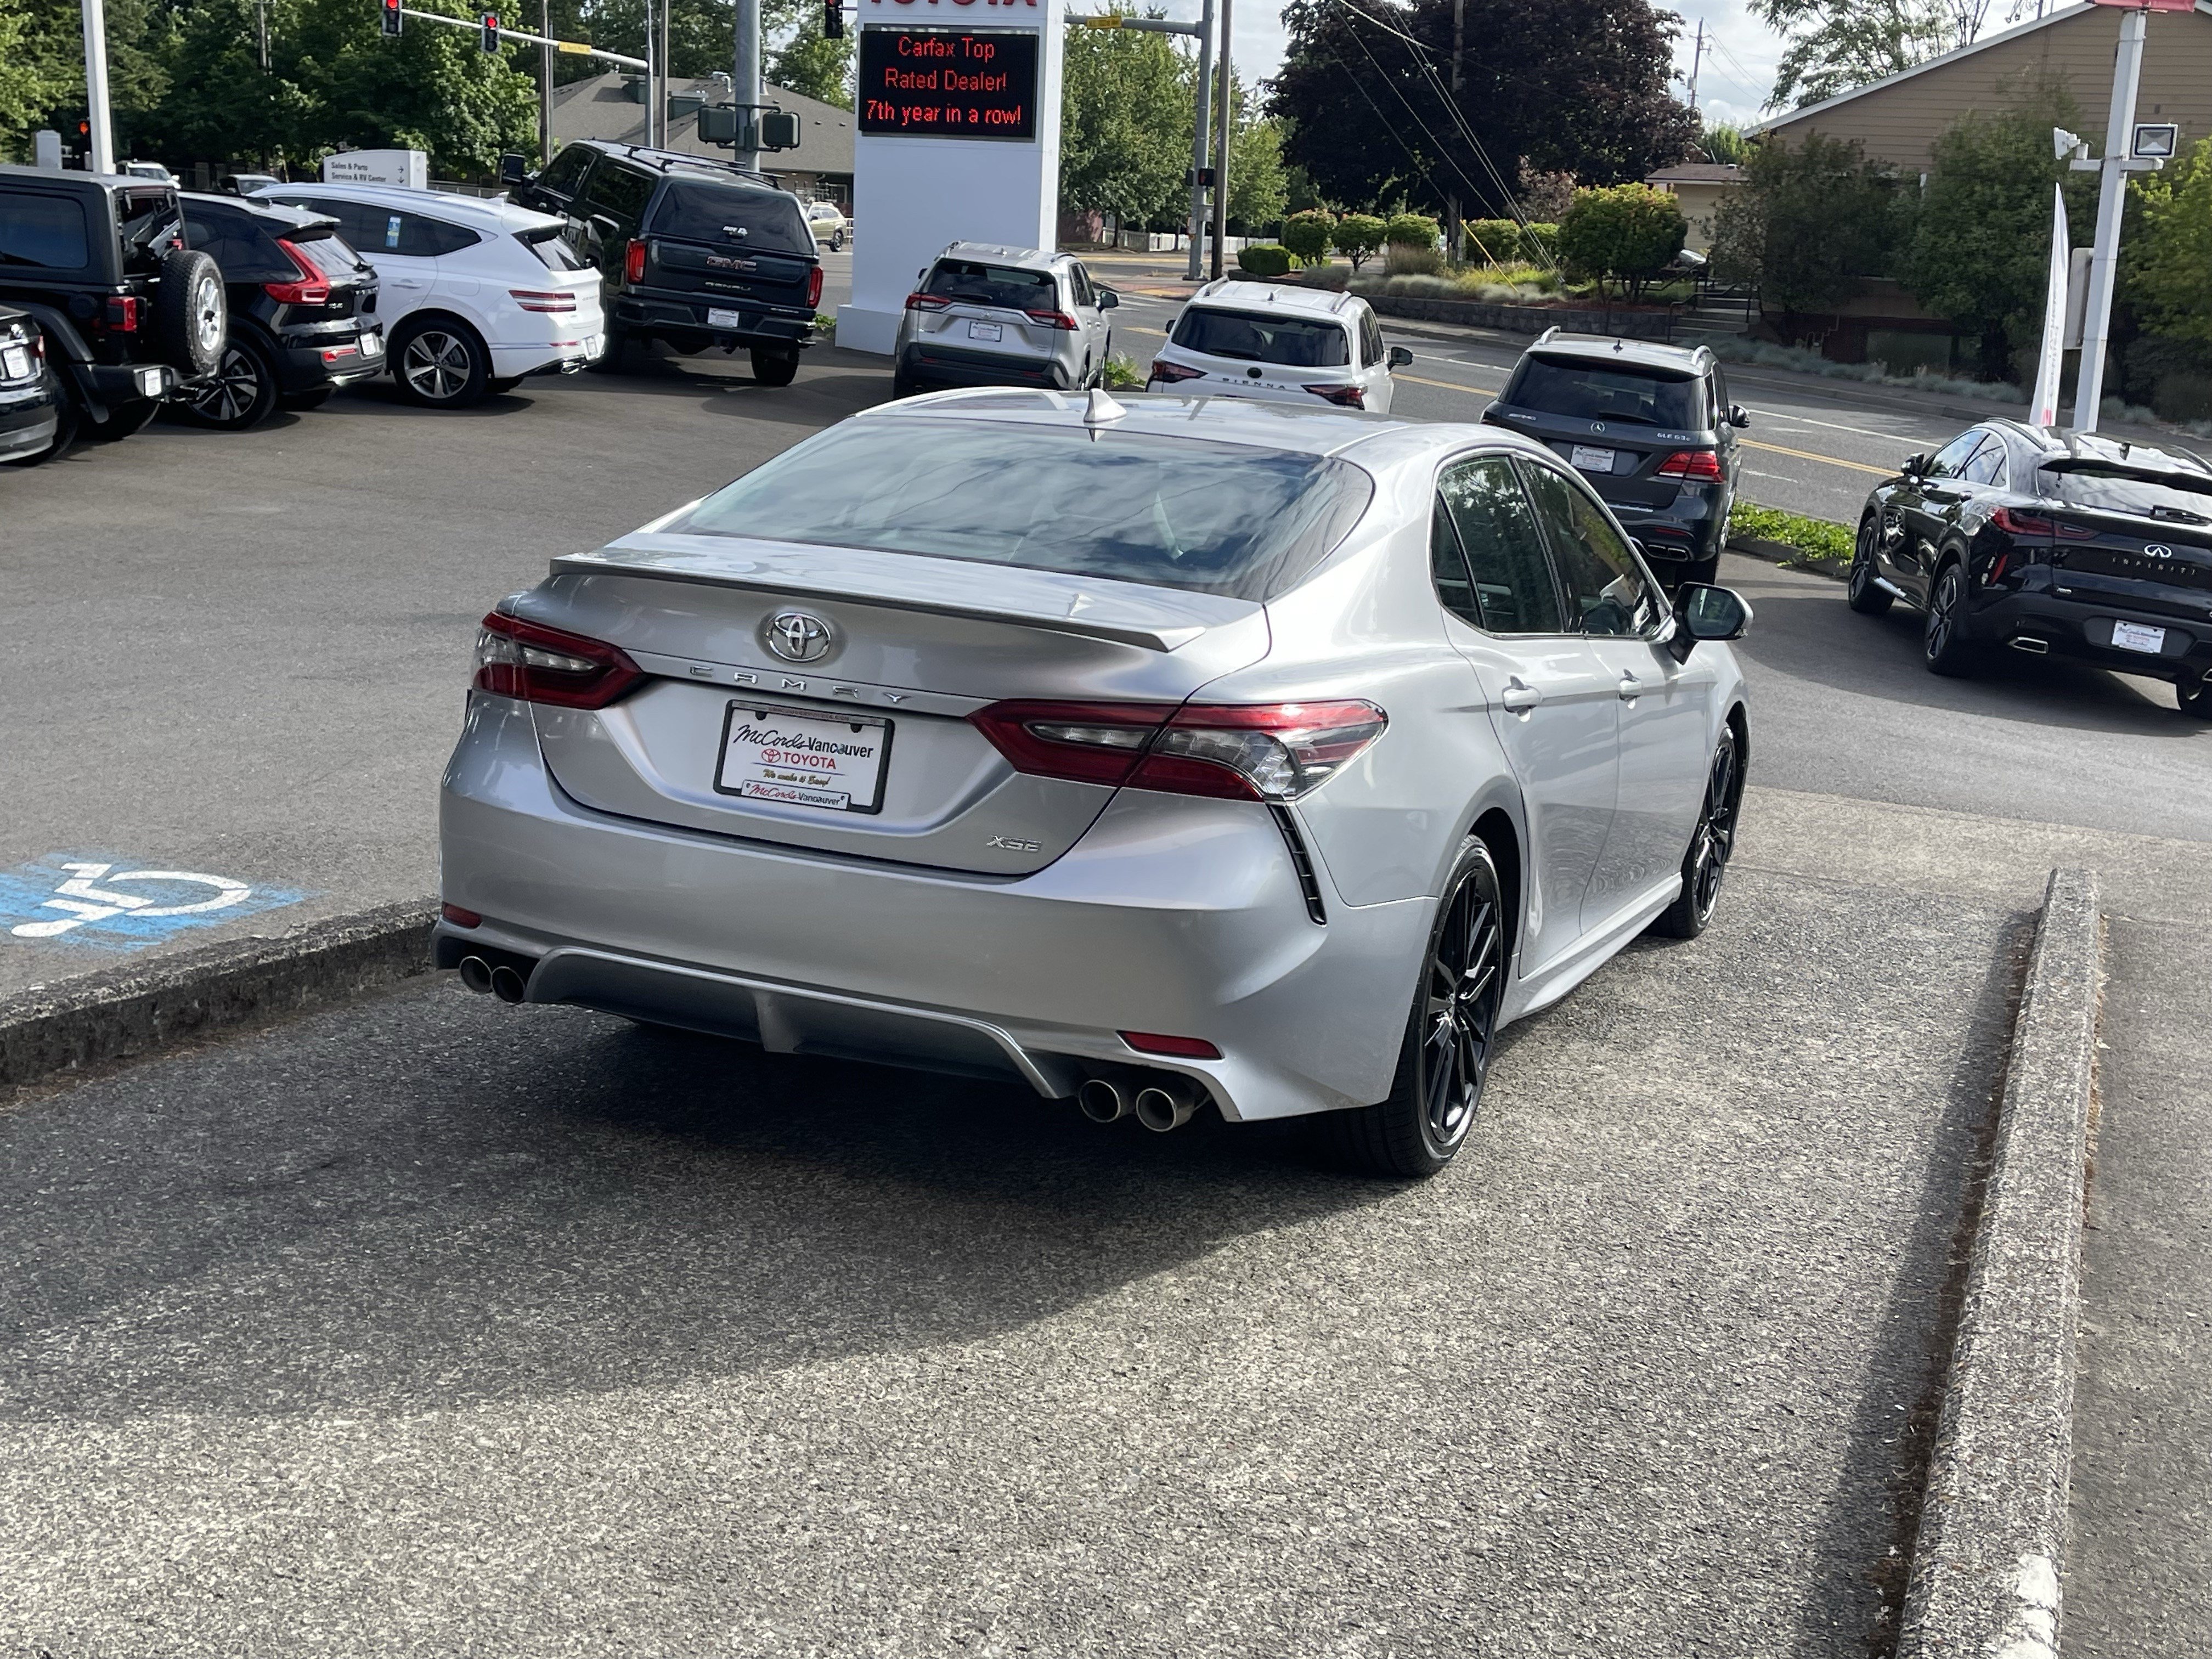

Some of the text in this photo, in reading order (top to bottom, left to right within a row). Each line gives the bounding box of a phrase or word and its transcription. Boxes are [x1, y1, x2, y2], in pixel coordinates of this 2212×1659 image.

[898, 36, 995, 64] Carfax Top
[885, 67, 1007, 92] Rated Dealer!
[866, 99, 1022, 126] 7th year in a row!
[331, 161, 346, 170] Sales
[353, 163, 368, 171] Parts
[331, 172, 352, 180] Service
[707, 256, 757, 272] GMC
[1222, 377, 1286, 390] SIENNA
[690, 665, 911, 704] CAMRY
[783, 752, 837, 770] TOYOTA
[986, 834, 1043, 853] XSE
